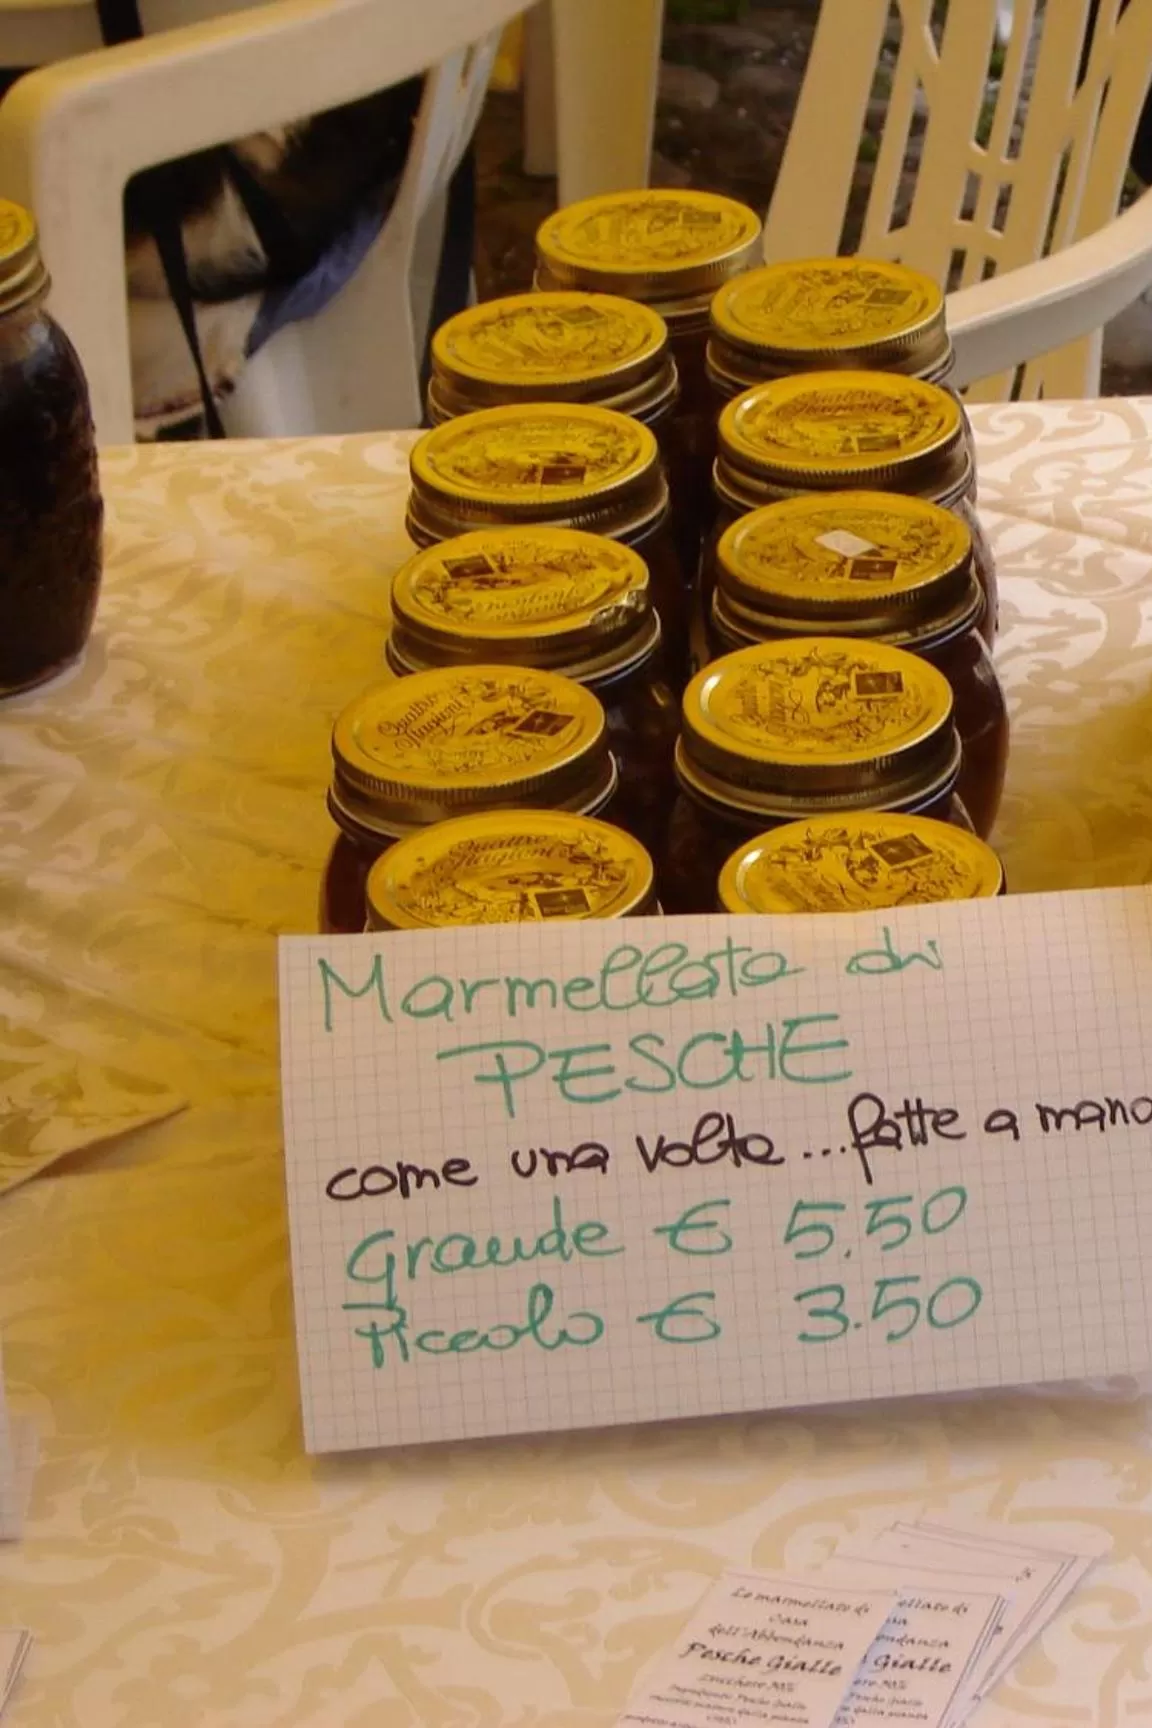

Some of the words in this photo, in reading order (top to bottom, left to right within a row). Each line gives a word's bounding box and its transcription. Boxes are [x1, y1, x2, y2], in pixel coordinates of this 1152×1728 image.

[318, 938, 804, 1032] Marmellata
[846, 928, 943, 976] di
[437, 1013, 854, 1119] PESCHE
[326, 1158, 478, 1201] come
[511, 1142, 610, 1178] una
[984, 1109, 1020, 1141] a
[346, 1197, 625, 1308] Grande
[783, 1187, 968, 1261] 5.50
[794, 1276, 982, 1344] 3.50
[678, 1640, 763, 1667] Pesche
[760, 1653, 843, 1677] Gialle
[868, 1653, 952, 1675] Gialle
